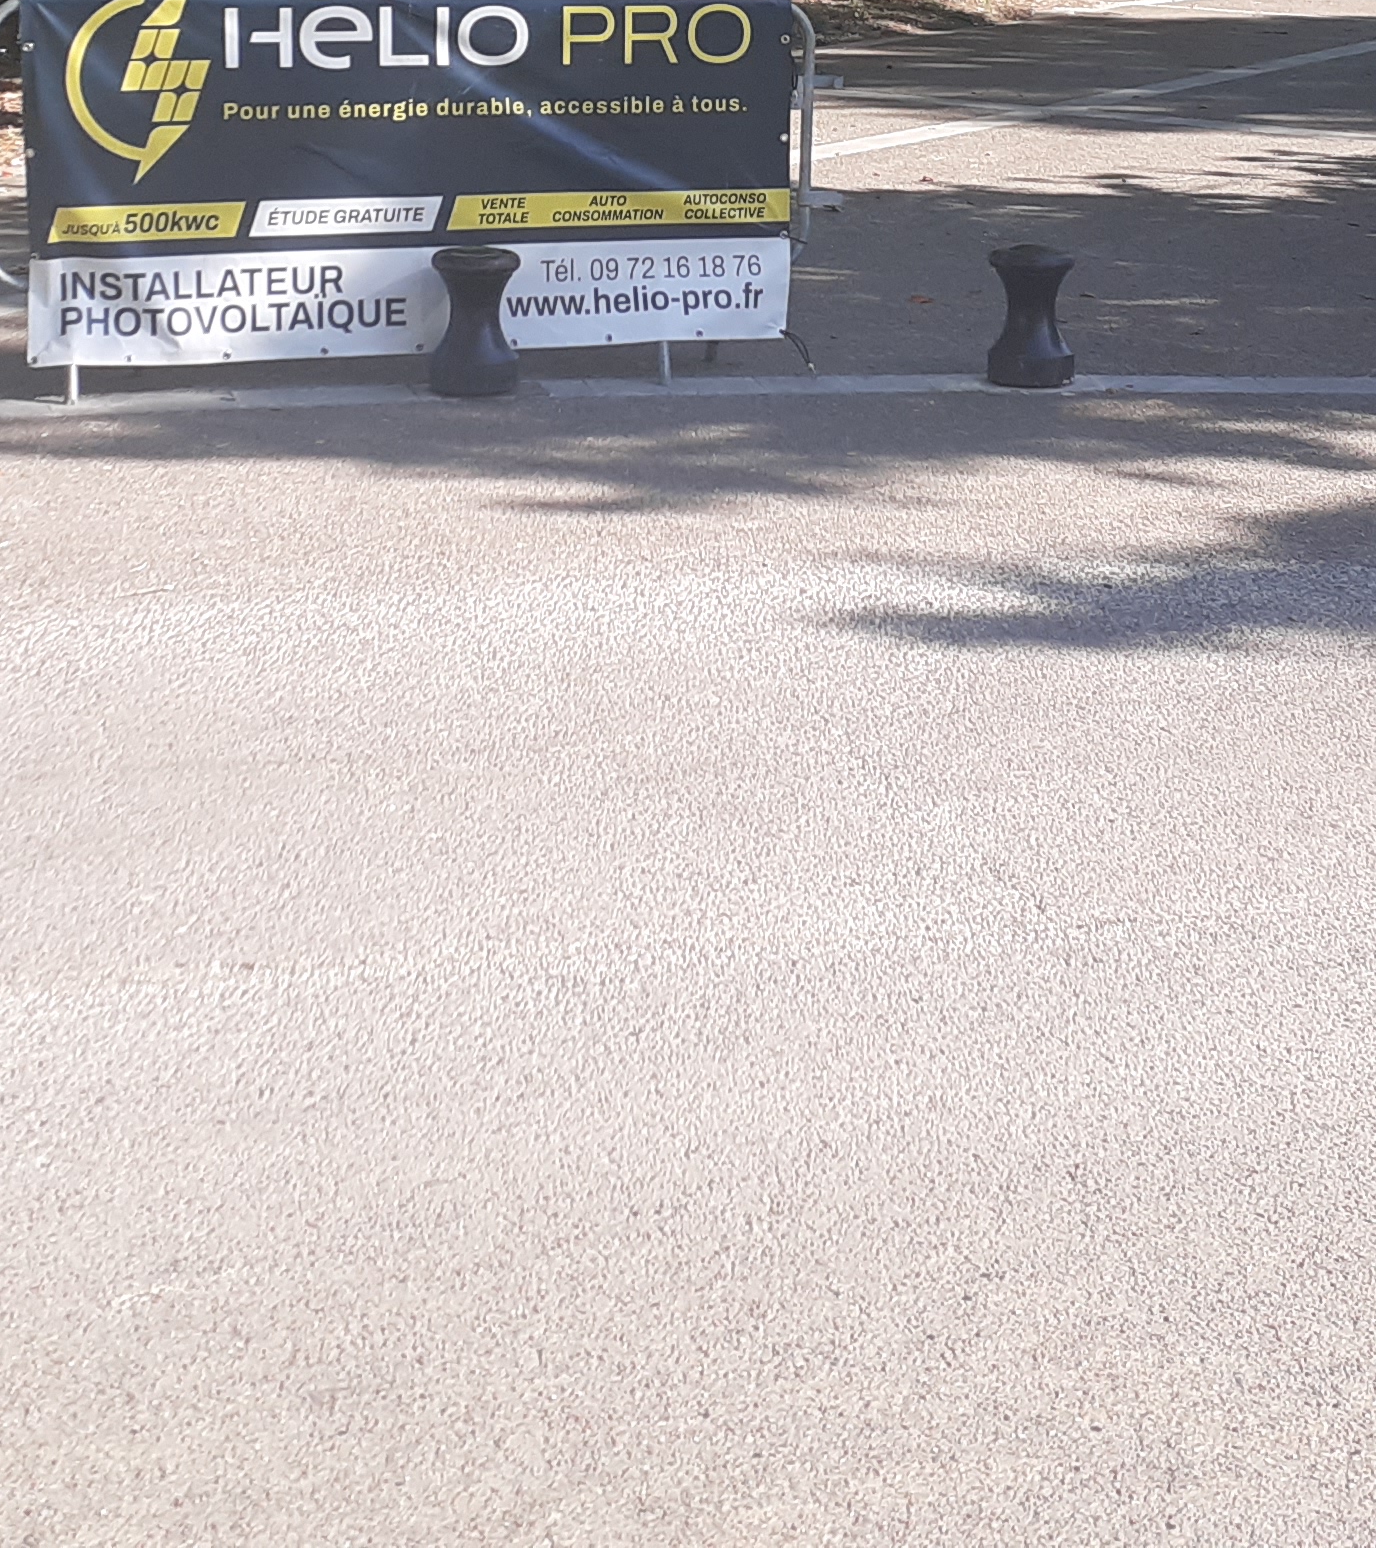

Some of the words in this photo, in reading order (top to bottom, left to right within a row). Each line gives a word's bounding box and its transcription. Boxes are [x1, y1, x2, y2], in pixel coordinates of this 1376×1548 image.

[562, 3, 752, 66] PRO
[223, 102, 280, 120] Pour
[287, 105, 331, 120] une
[338, 99, 429, 122] énergie
[436, 97, 533, 119] durable,
[540, 96, 665, 115] accessible
[672, 95, 685, 114] à
[692, 95, 748, 113] tous.
[481, 197, 527, 210] VENTE
[588, 194, 628, 208] AUTO
[683, 192, 768, 206] AUTOCONSO
[61, 221, 122, 237] JUSQU'À
[123, 210, 221, 235] 500kwc
[266, 206, 331, 227] ÉTUDE
[333, 207, 425, 225] GRATUITE
[478, 211, 530, 226] TOTALE
[552, 208, 664, 223] CONSOMMATION
[684, 206, 765, 220] COLLECTIVE
[540, 258, 582, 283] Tél.
[590, 257, 620, 281] 09
[626, 256, 656, 280] 72
[663, 255, 690, 279] 16
[698, 254, 725, 278] 18
[732, 253, 763, 277] 76
[59, 265, 345, 302] INSTALLATEUR
[505, 282, 764, 318] www.helio-pro.fr
[59, 292, 408, 337] PHOTOVOLTAÏQUE
